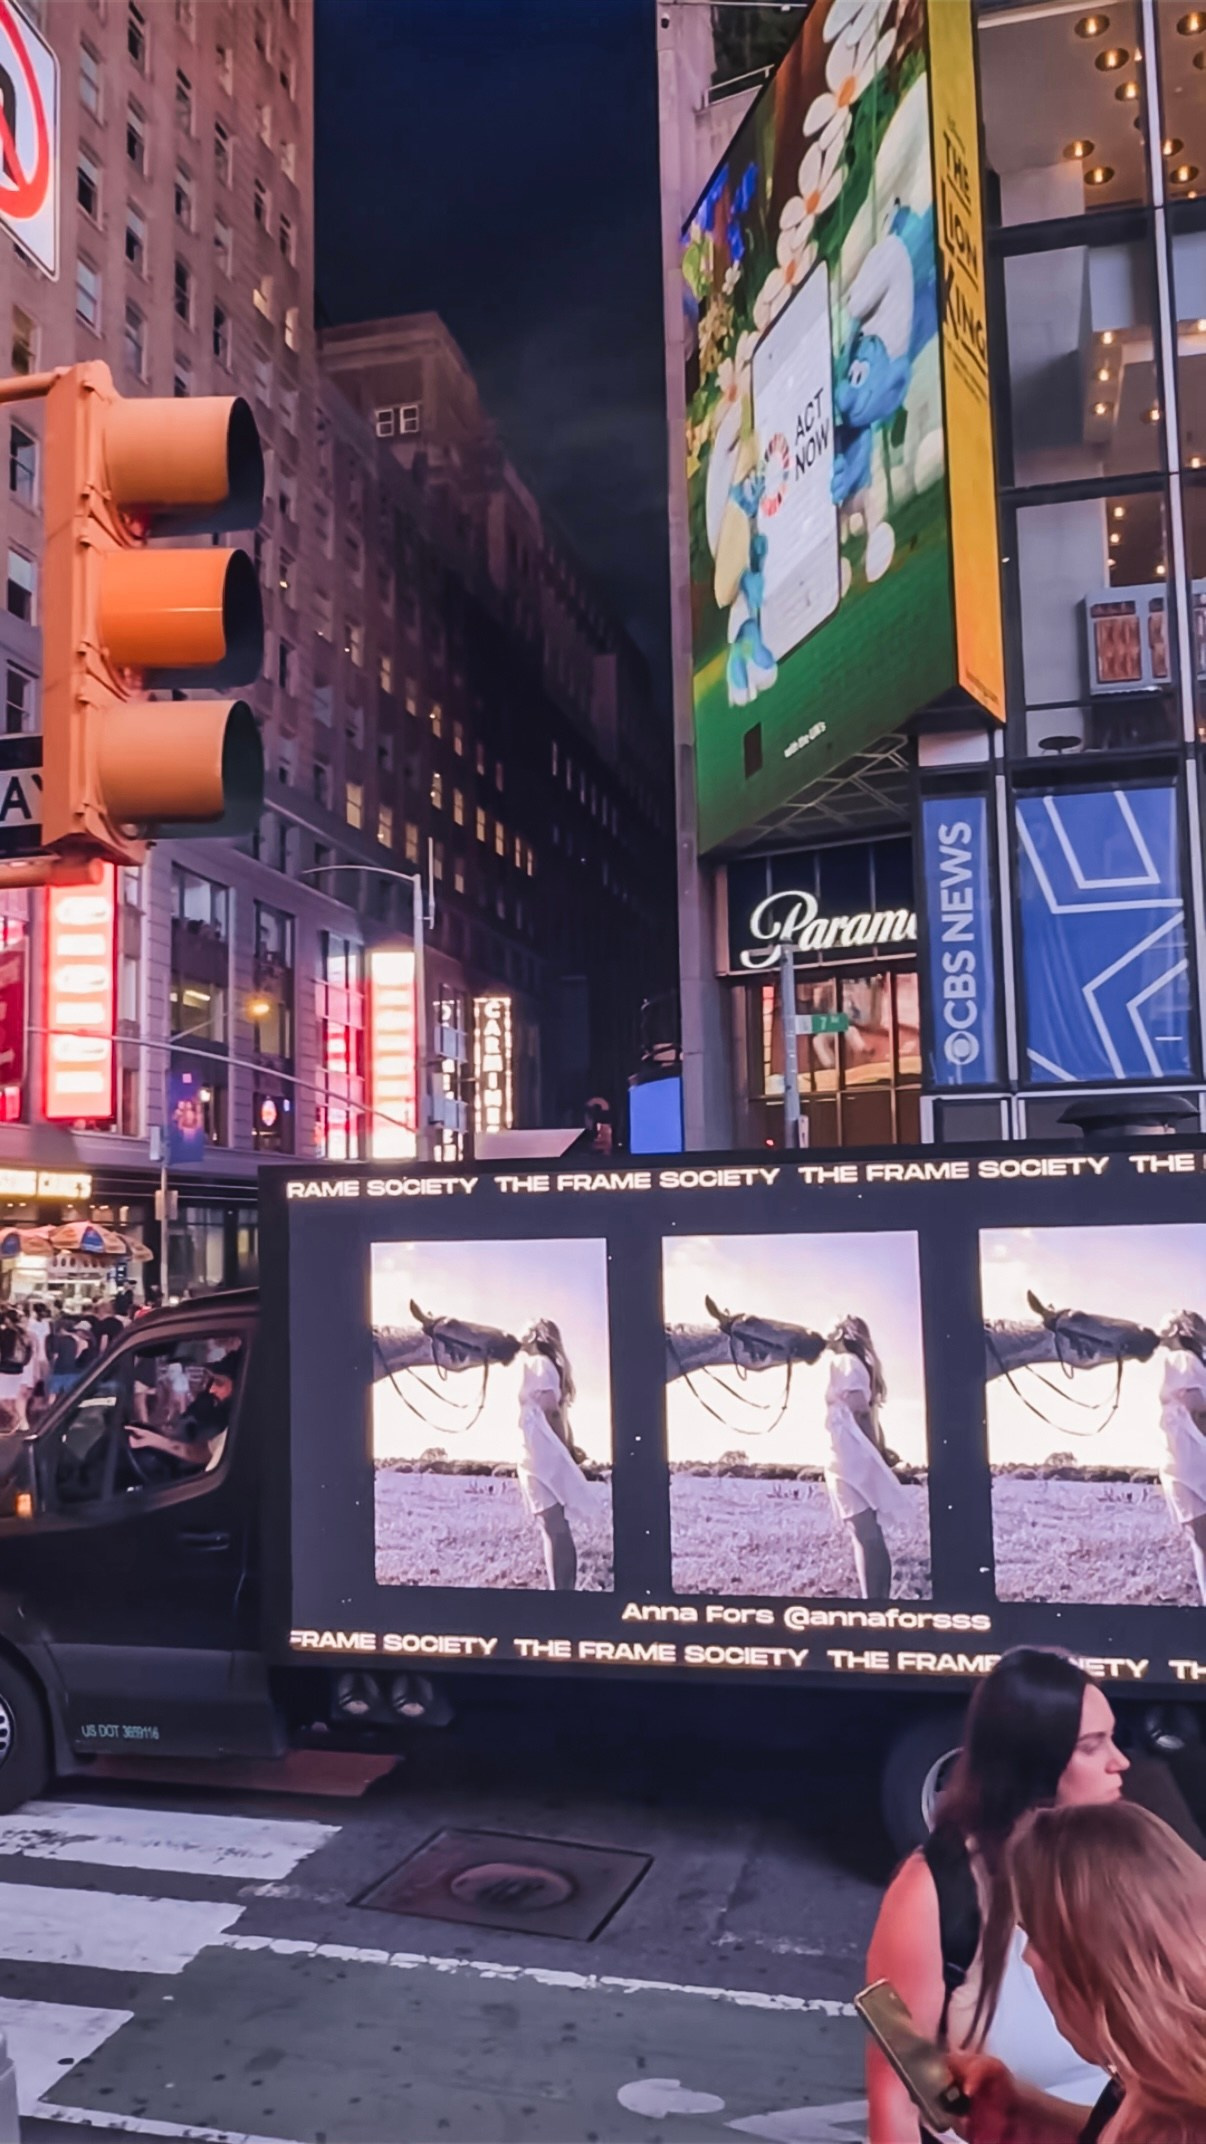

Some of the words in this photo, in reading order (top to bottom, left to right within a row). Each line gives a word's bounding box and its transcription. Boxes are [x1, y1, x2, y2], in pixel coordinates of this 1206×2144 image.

[795, 387, 824, 446] ACT
[796, 417, 830, 481] NOW
[938, 821, 975, 942] NEWS
[942, 949, 977, 1030] CBS
[366, 1176, 479, 1197] SOCIETY
[494, 1174, 550, 1193] THE
[556, 1172, 652, 1192] FRAME
[659, 1167, 781, 1188] SOCIETY
[797, 1165, 858, 1184] THE
[866, 1161, 970, 1182] FRAME
[978, 1156, 1110, 1179] SOCIETY
[1128, 1153, 1196, 1174] THE
[621, 1602, 699, 1623] Anna
[706, 1605, 775, 1625] Fors
[783, 1606, 992, 1632] @annaforsss
[383, 1632, 498, 1656] SOCIETY
[513, 1638, 572, 1659] THE
[578, 1641, 677, 1663] FRAME
[684, 1644, 810, 1668] SOCIETY
[826, 1649, 890, 1670] THE
[81, 1724, 97, 1738] US
[98, 1724, 120, 1738] DOT
